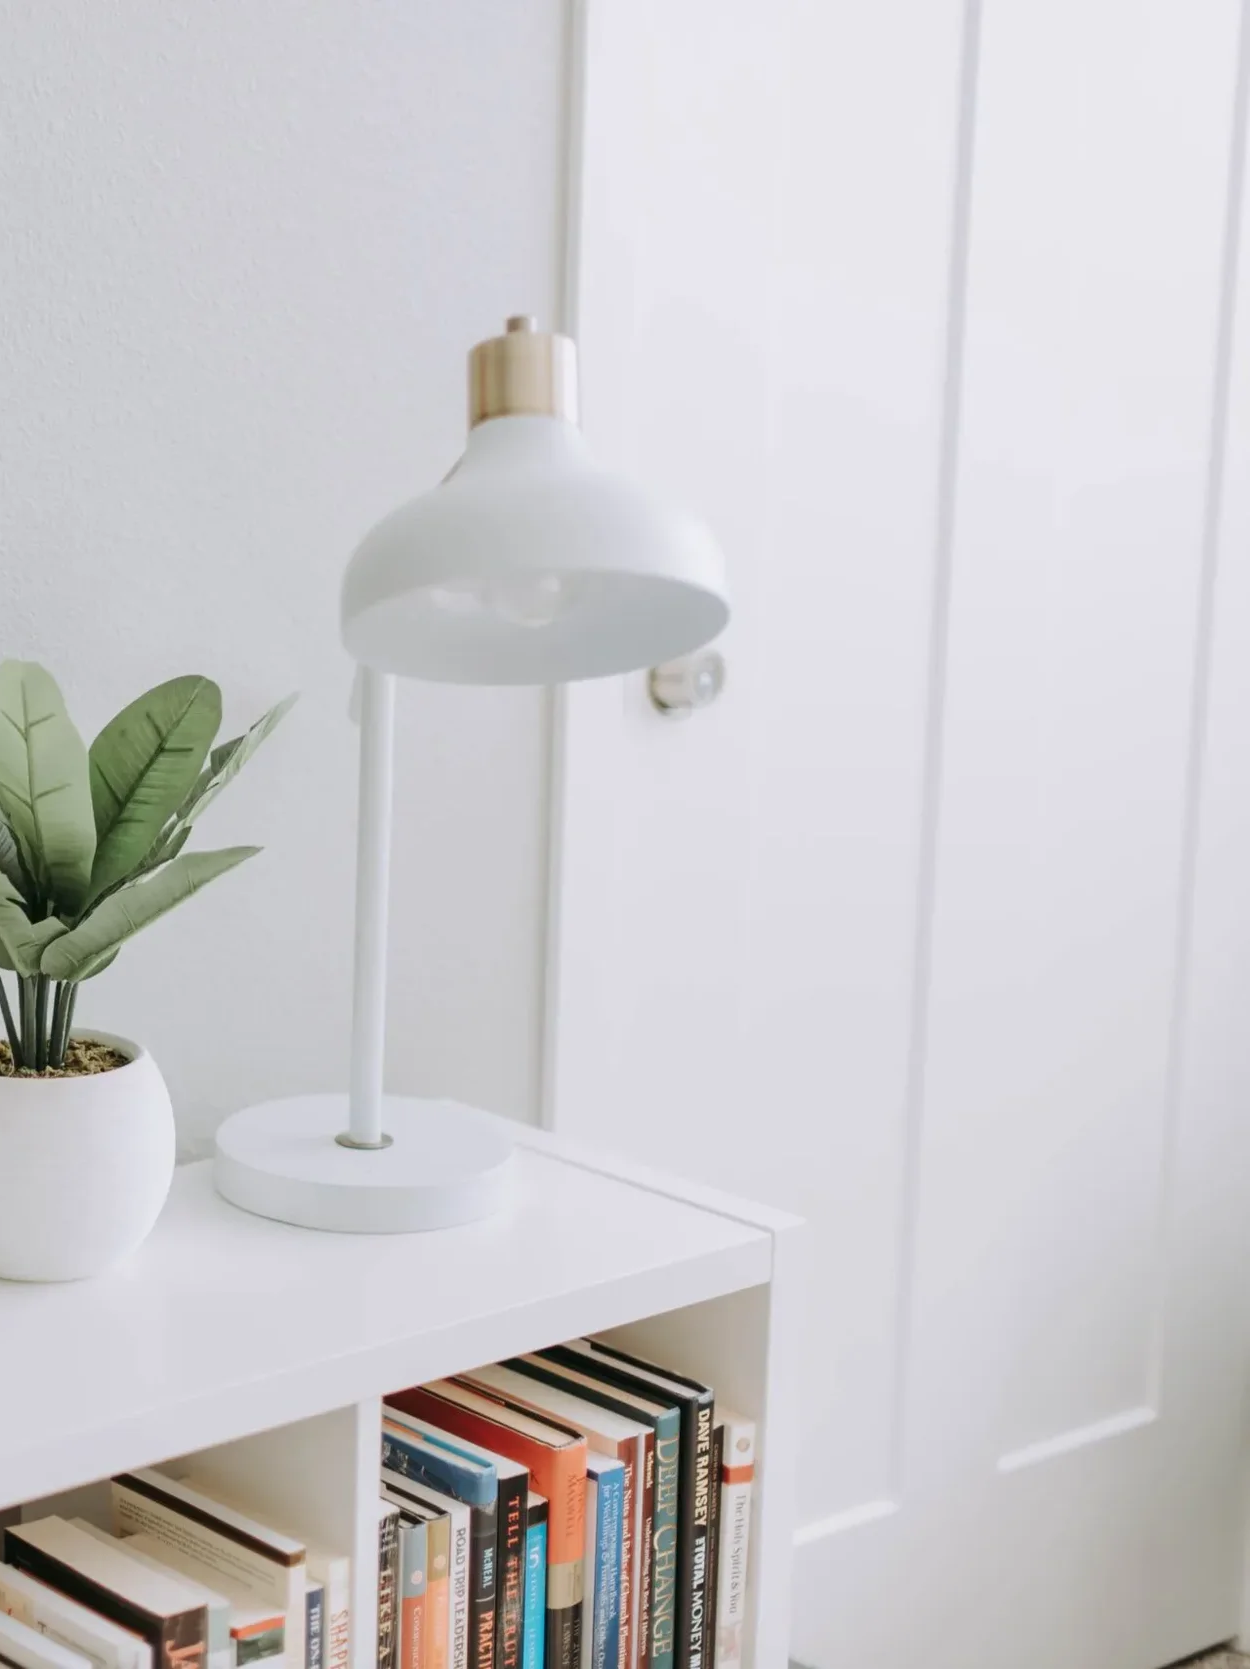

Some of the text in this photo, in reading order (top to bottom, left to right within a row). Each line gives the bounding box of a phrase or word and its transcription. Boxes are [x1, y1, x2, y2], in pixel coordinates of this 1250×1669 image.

[624, 1464, 633, 1487] The
[693, 1408, 710, 1527] DAVE RAMSEY
[623, 1489, 631, 1518] Nuts
[734, 1494, 747, 1517] The
[507, 1496, 520, 1549] TELL
[600, 1500, 611, 1549] Weddings
[622, 1519, 630, 1539] and
[731, 1518, 745, 1545] Holy
[455, 1527, 467, 1565] ROAD
[621, 1541, 630, 1569] Bolts
[653, 1434, 679, 1658] DEEP CHANGE
[729, 1546, 743, 1580] Spirit
[454, 1569, 465, 1599] TRIP
[482, 1547, 493, 1589] McNEAL
[505, 1556, 519, 1599] THE
[692, 1544, 706, 1589] TOTAL
[379, 1568, 393, 1635] LIKE
[619, 1582, 629, 1625] Church
[728, 1592, 740, 1615] You
[310, 1604, 321, 1636] THE
[562, 1622, 571, 1650] LAWS
[690, 1591, 704, 1652] MONEY
[379, 1645, 391, 1660] A
[477, 1611, 494, 1669] PRACTI
